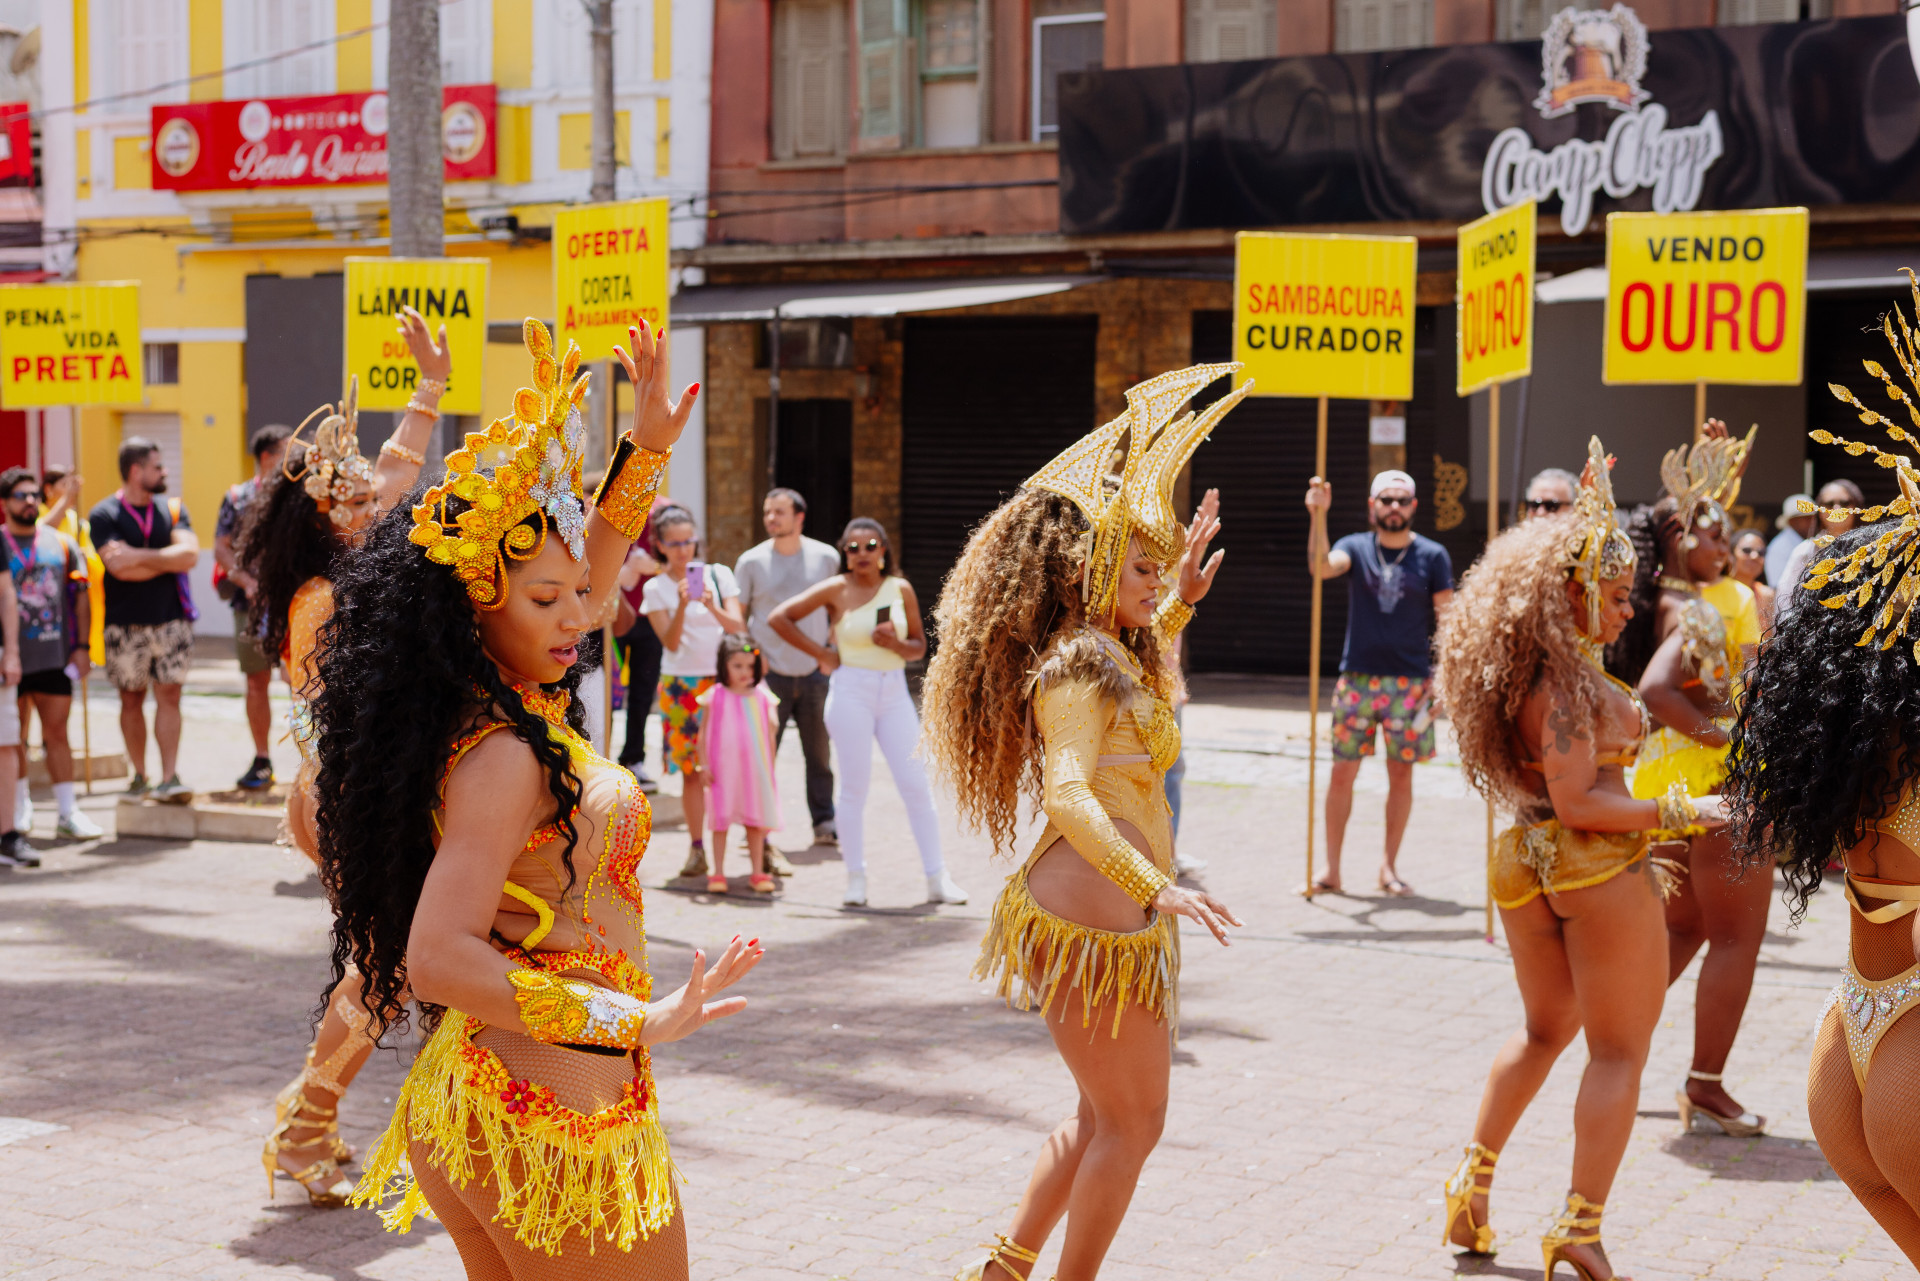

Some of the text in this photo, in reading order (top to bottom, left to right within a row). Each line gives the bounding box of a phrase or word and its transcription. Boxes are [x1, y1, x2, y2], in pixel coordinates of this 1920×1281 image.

[228, 134, 389, 182] Bento Quirin
[567, 227, 649, 260] OFERTA
[1473, 229, 1518, 270] VENDO
[1648, 237, 1765, 262] VENDO
[581, 275, 633, 305] CORTA
[1248, 283, 1404, 318] SAMBACURA
[1464, 271, 1526, 363] OURO
[1620, 281, 1787, 354] OURO
[64, 331, 119, 348] VIDA
[1247, 324, 1403, 354] CURADOR
[13, 354, 131, 382] PRETA
[369, 365, 452, 391] COR
